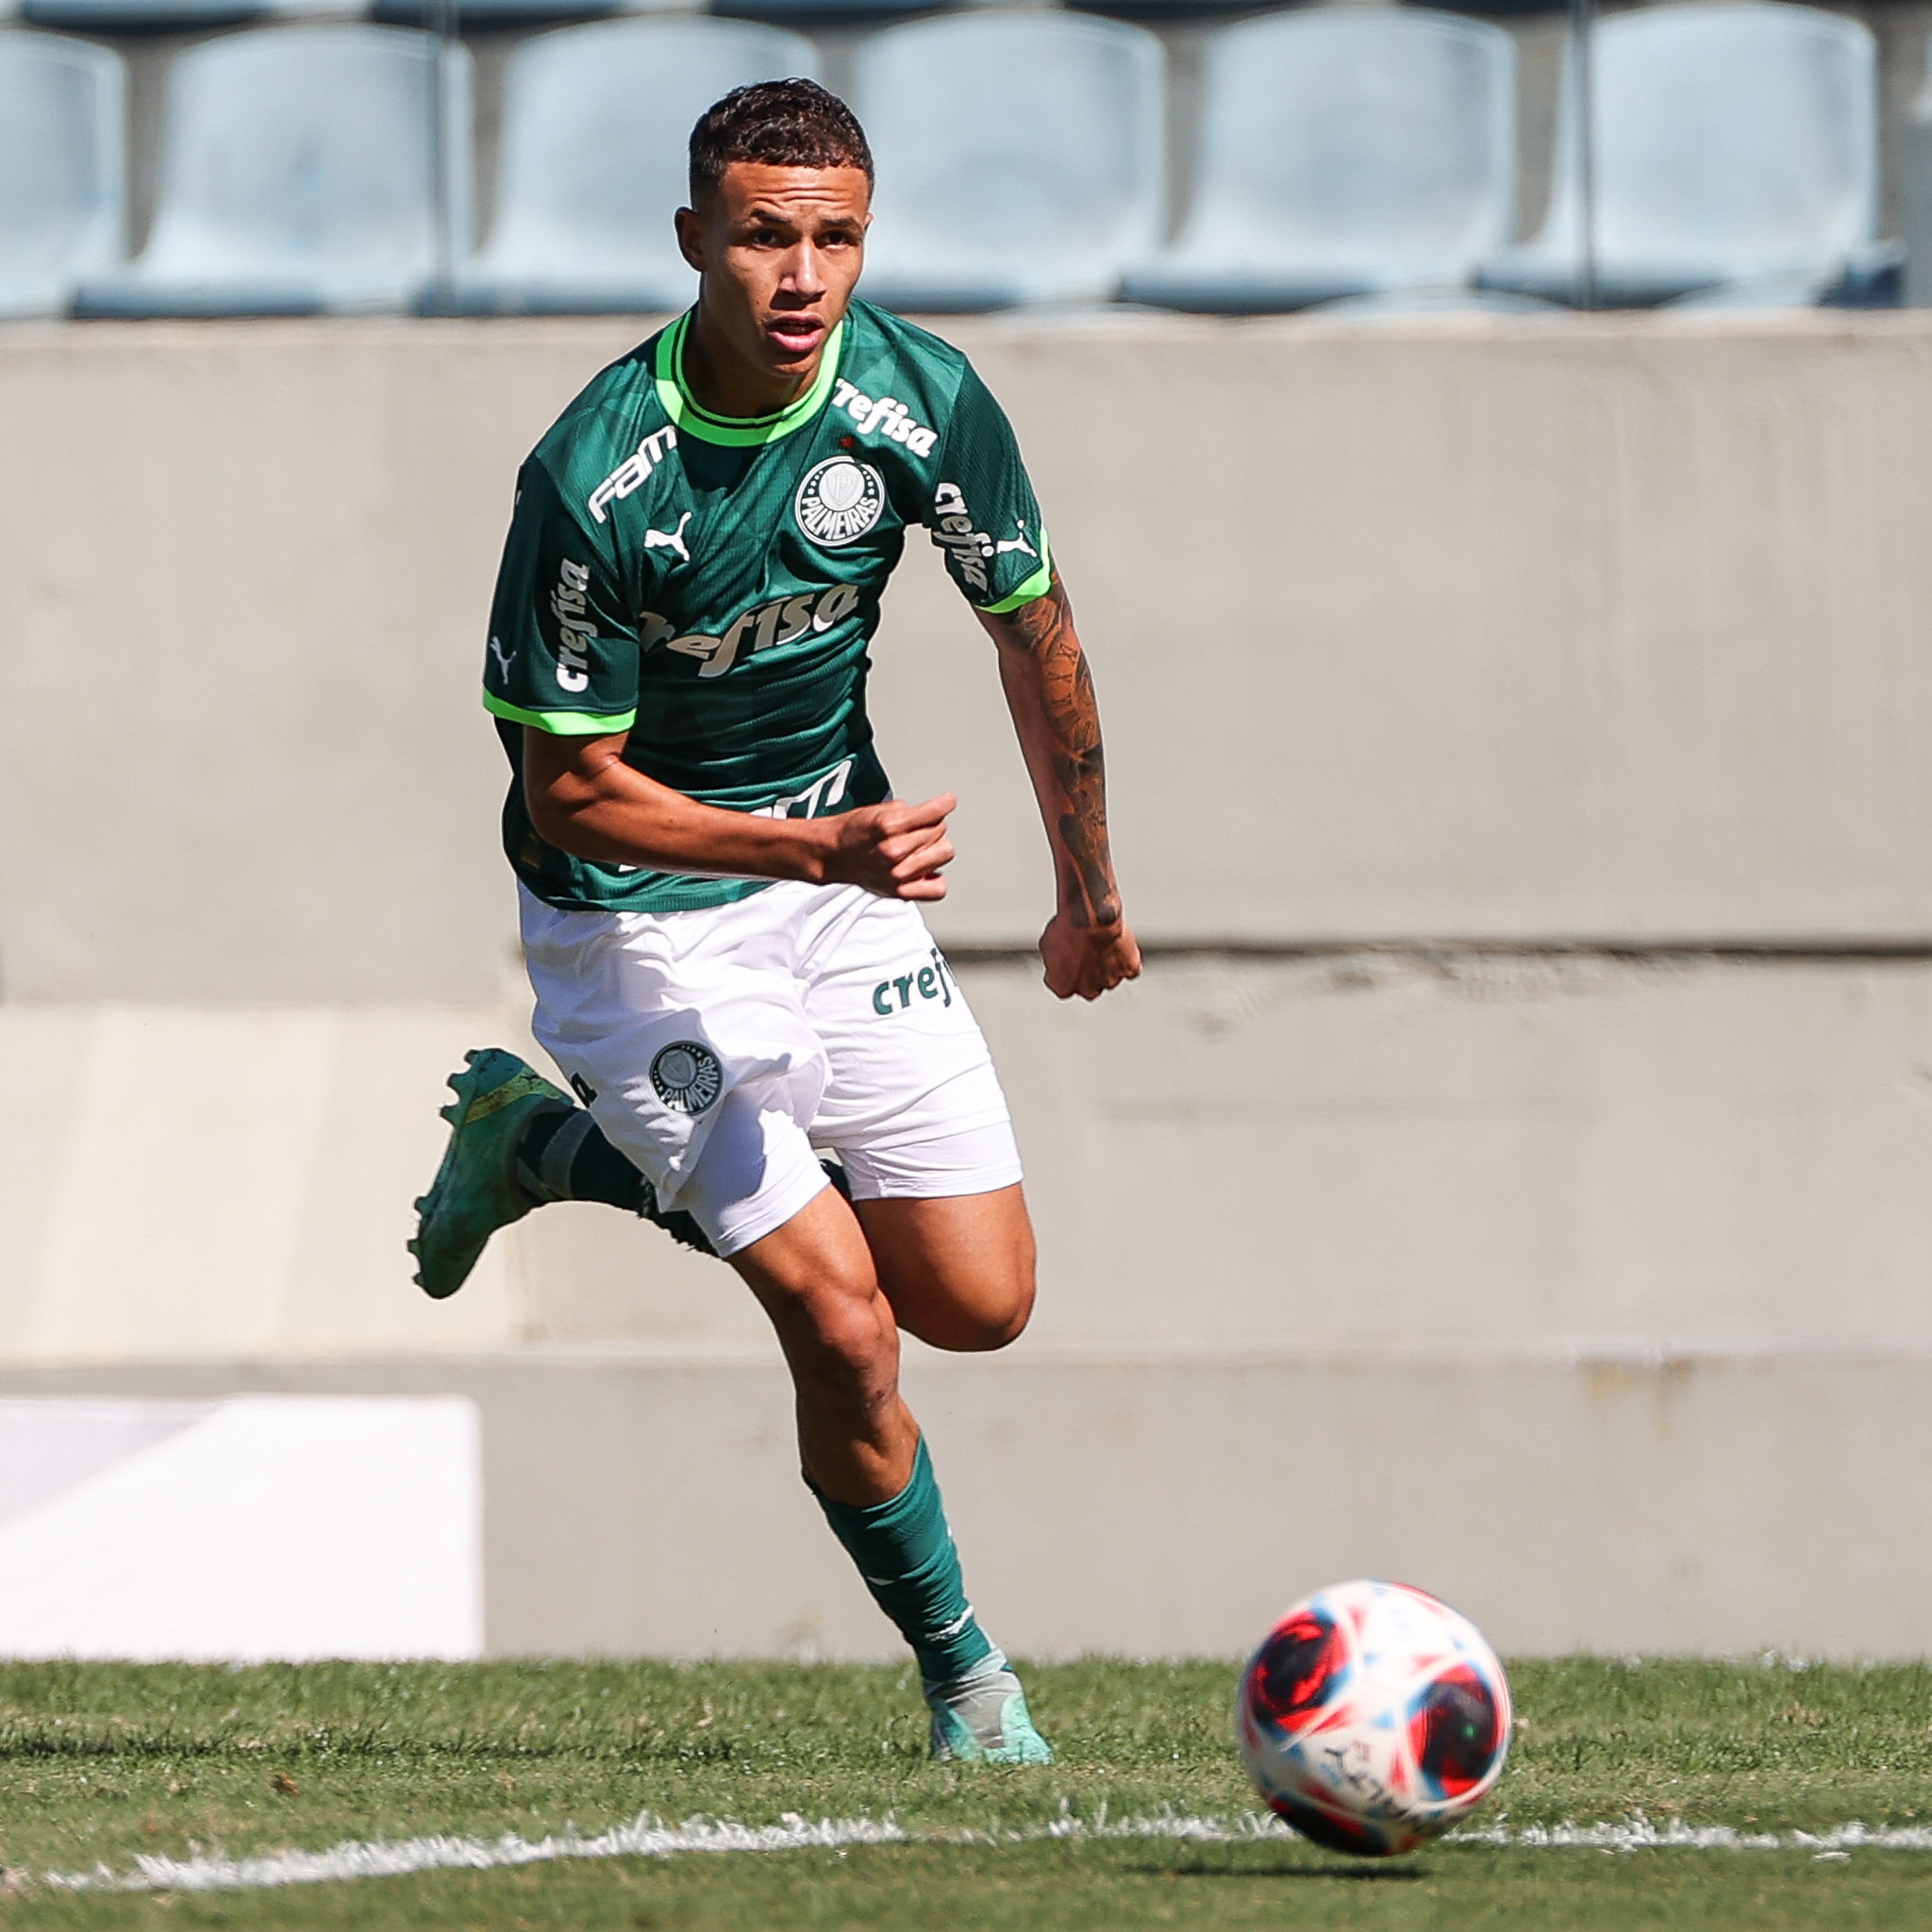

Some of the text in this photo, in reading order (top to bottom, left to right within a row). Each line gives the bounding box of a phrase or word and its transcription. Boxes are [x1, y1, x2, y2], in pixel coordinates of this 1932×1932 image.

[832, 377, 939, 458] refisa
[801, 496, 878, 540] PALMEIRAS
[935, 482, 994, 592] crefisa
[550, 558, 597, 692] crefisa
[638, 583, 859, 678] refisa
[661, 1056, 718, 1111] PALMEIRAS
